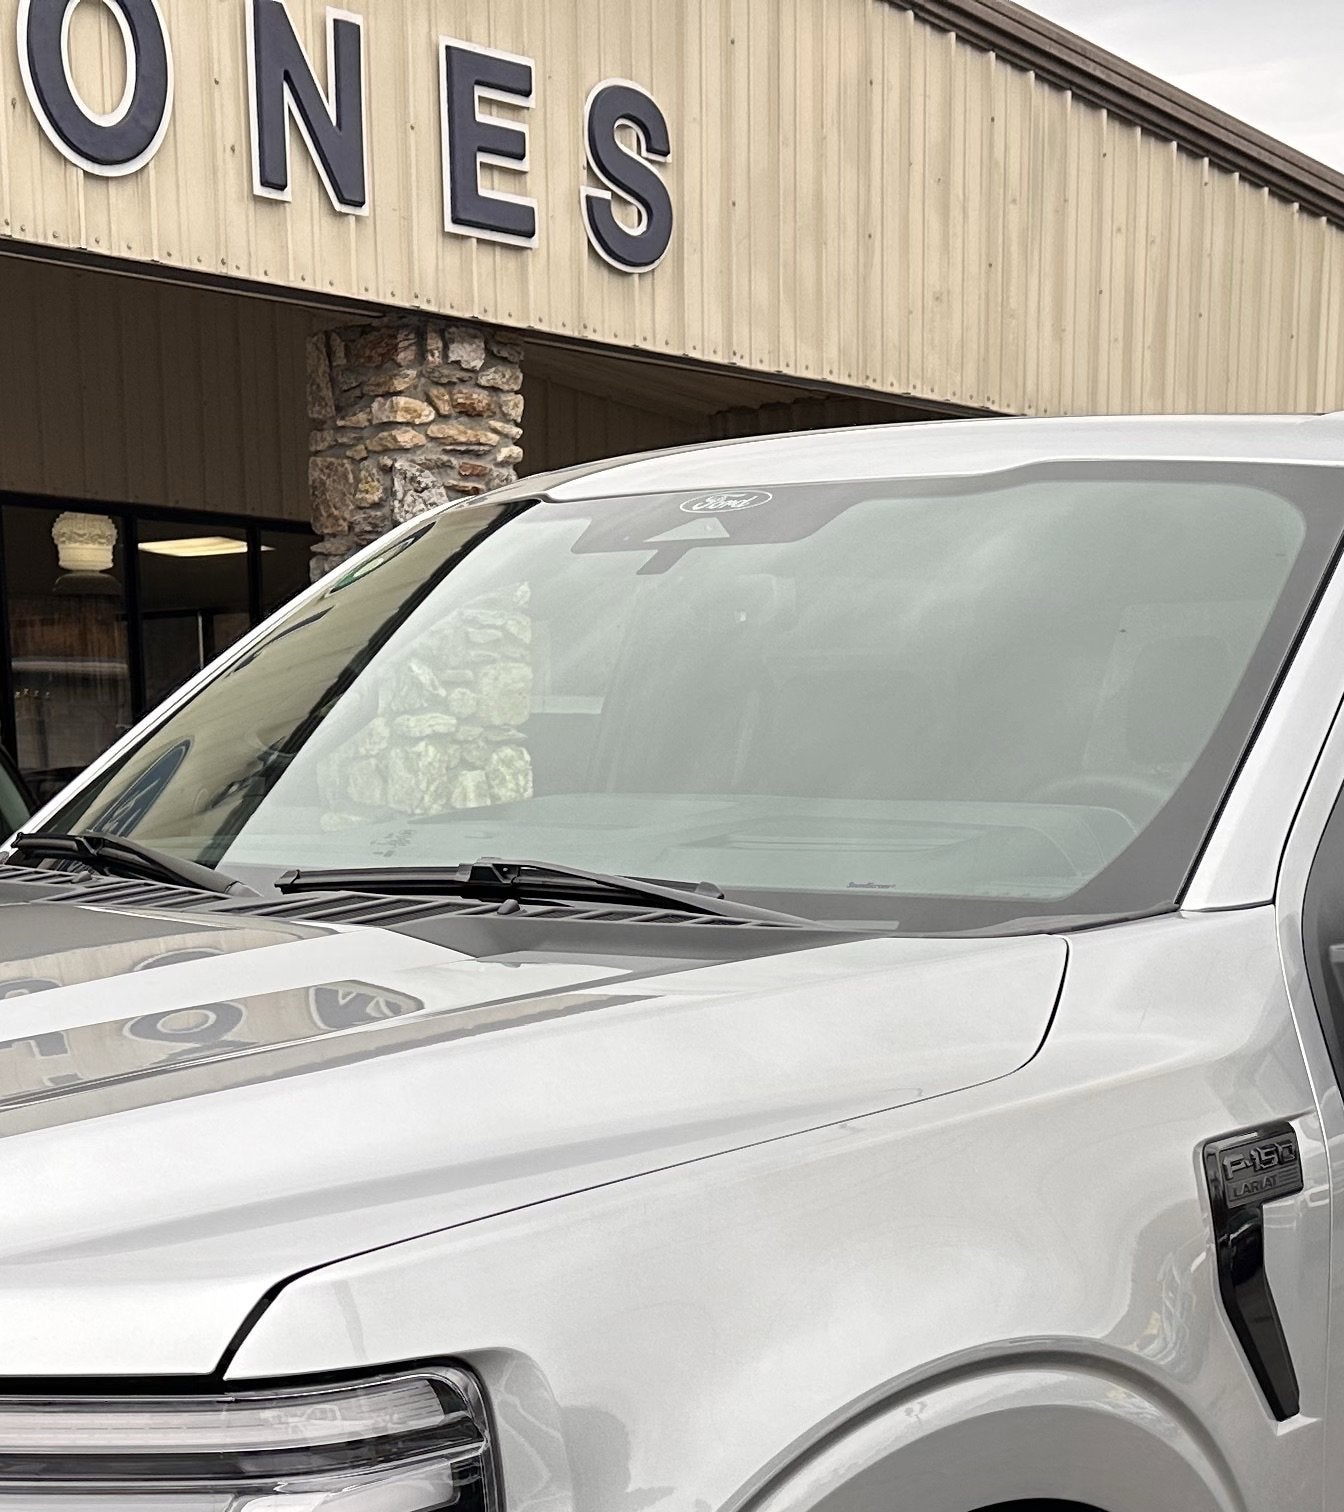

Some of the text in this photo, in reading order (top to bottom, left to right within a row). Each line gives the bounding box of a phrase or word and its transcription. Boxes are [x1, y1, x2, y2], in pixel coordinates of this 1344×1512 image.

[691, 492, 759, 511] Ford
[1223, 1140, 1296, 1181] F-150
[1233, 1173, 1279, 1198] LARIAT
